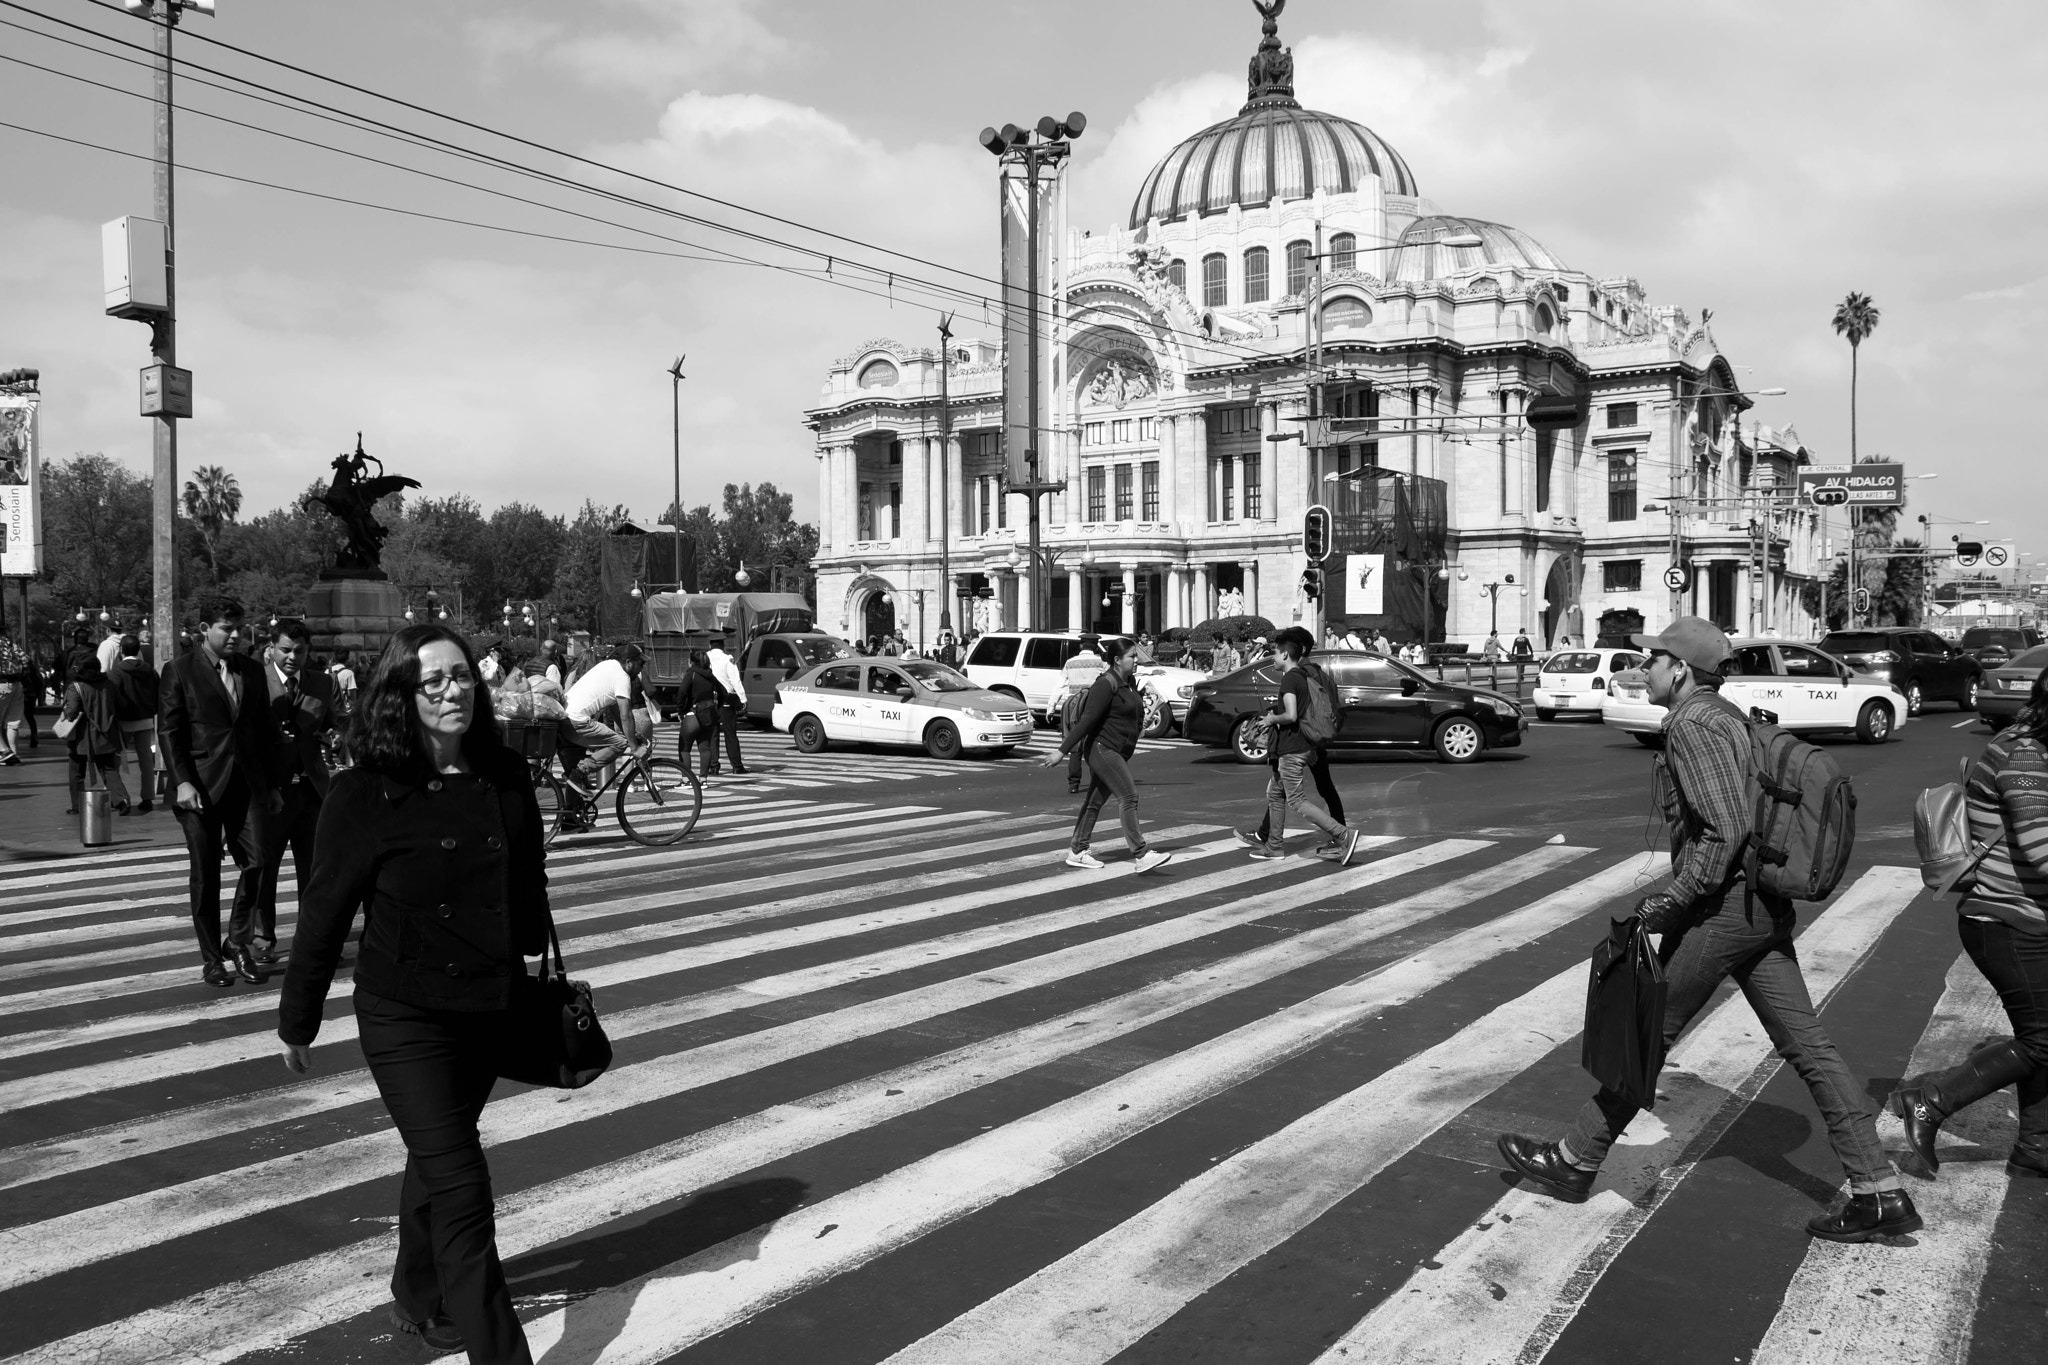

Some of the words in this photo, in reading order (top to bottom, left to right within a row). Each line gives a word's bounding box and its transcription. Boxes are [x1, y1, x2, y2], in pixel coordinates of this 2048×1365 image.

[1332, 314, 1363, 322] ARQUITECTURA
[1825, 477, 1842, 487] AV
[1845, 476, 1895, 486] HIDALGO
[9, 488, 21, 542] Senosiain
[1751, 689, 1783, 699] CDMX
[1807, 690, 1838, 700] TAXI
[829, 706, 856, 718] CDMX
[881, 710, 901, 720] TAXI
